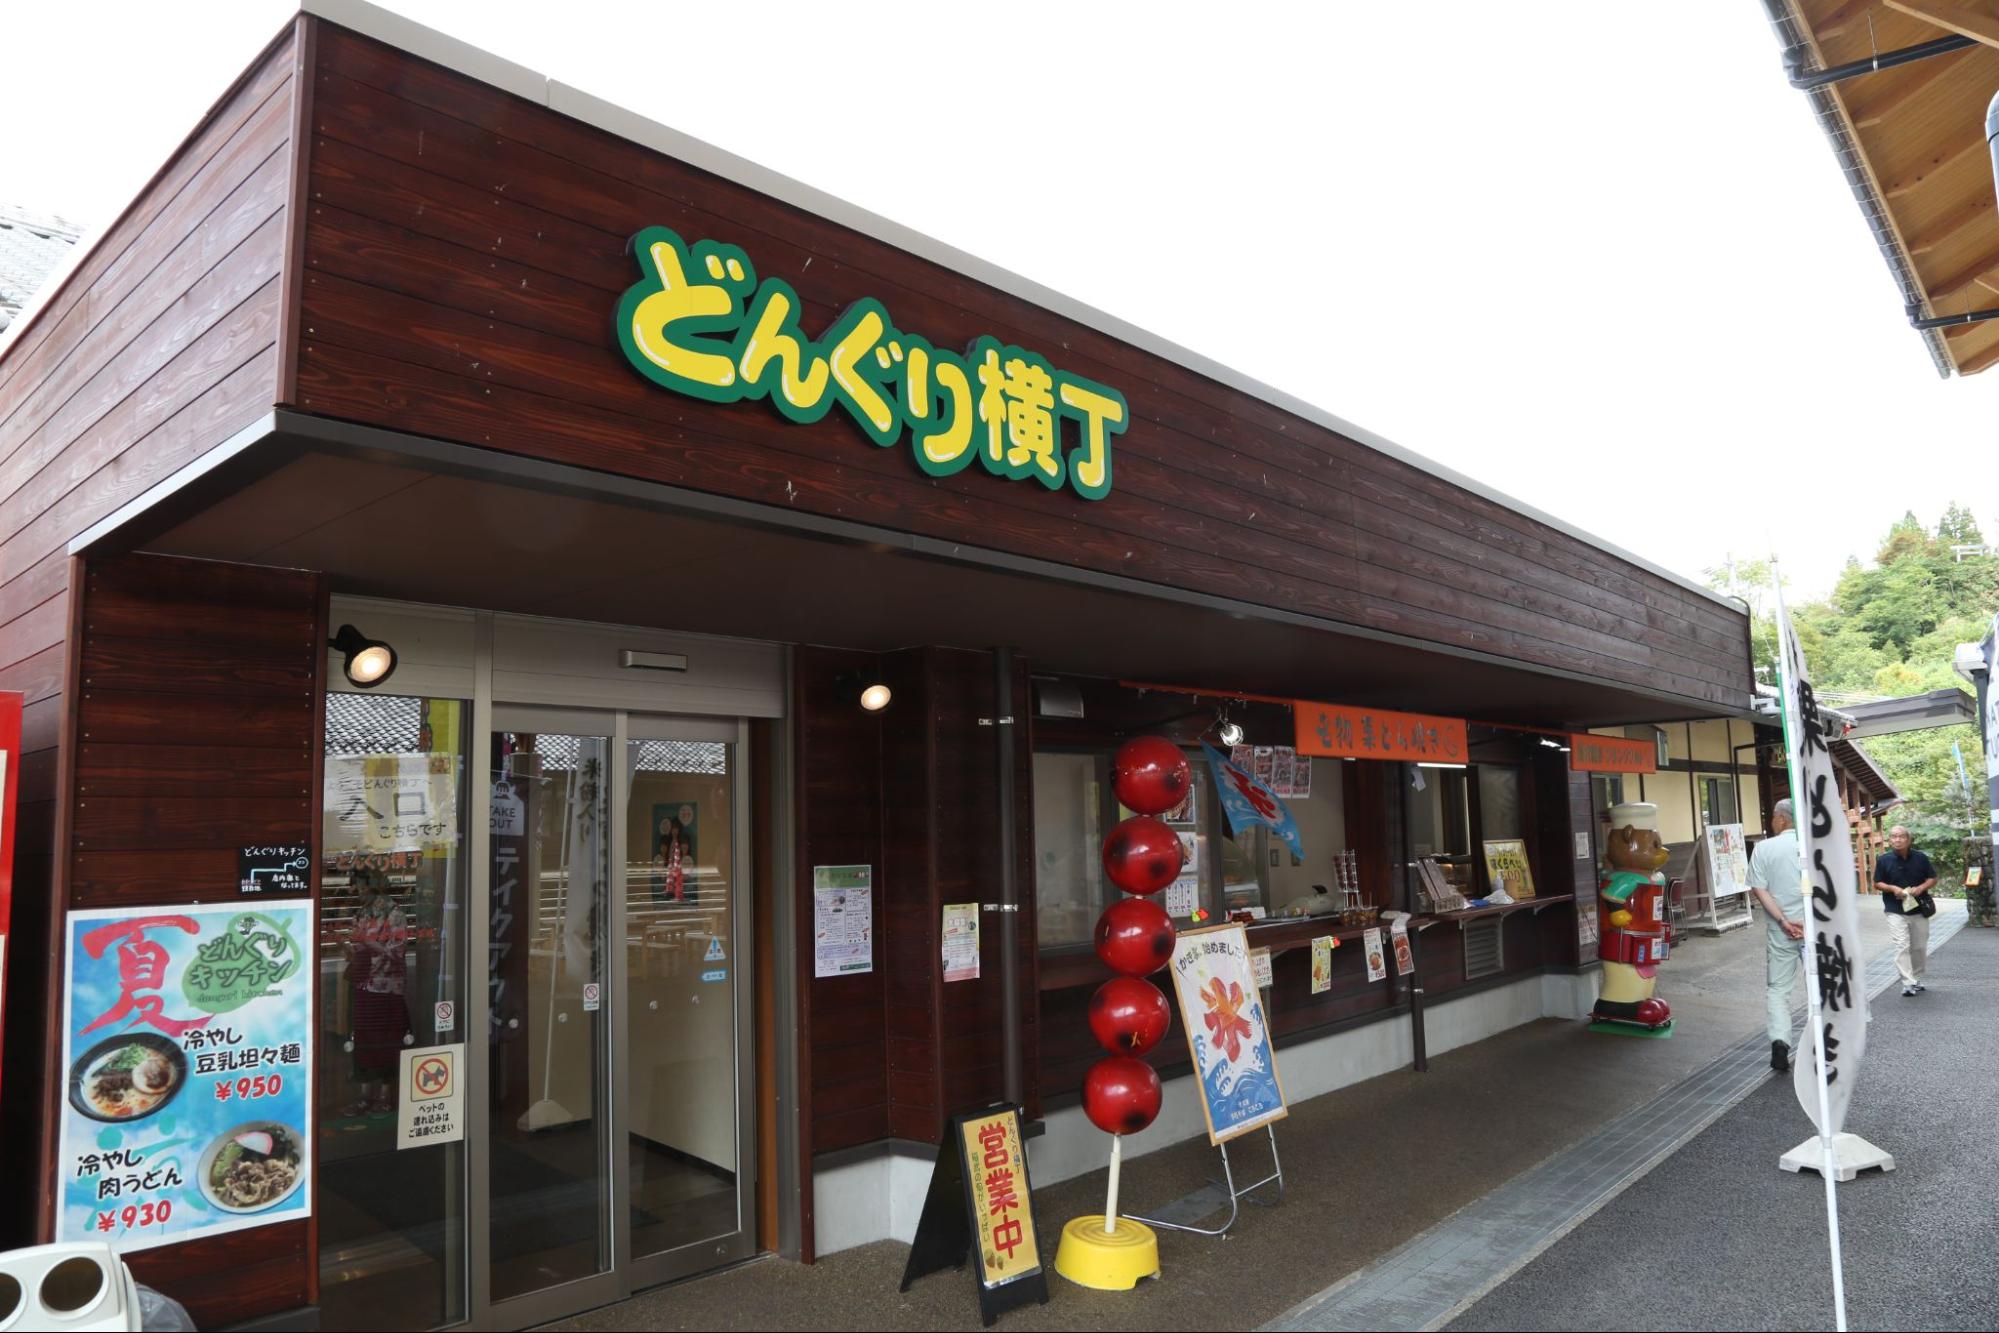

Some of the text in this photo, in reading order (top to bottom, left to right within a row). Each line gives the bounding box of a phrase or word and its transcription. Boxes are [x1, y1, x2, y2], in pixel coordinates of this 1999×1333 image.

[625, 233, 1126, 493] どんぐり横丁
[340, 793, 425, 820] 入口
[380, 822, 446, 838] こちらです
[244, 846, 305, 857] どんぐりキッチン
[197, 931, 288, 962] どんぐり
[78, 914, 216, 1037] 夏
[190, 959, 293, 990] キッチン
[1200, 977, 1252, 1063] 氷
[184, 1027, 243, 1050] 冷やし
[196, 1043, 300, 1074] 豆乳坦々麺
[216, 1074, 282, 1100] ¥950
[408, 1124, 454, 1138] ご遠慮ください
[413, 1113, 449, 1125] 連れ込みは
[77, 1149, 143, 1176] 冷やし
[98, 1168, 182, 1199] 肉うどん
[979, 1121, 1022, 1259] 営業中
[98, 1200, 172, 1232] ¥930
